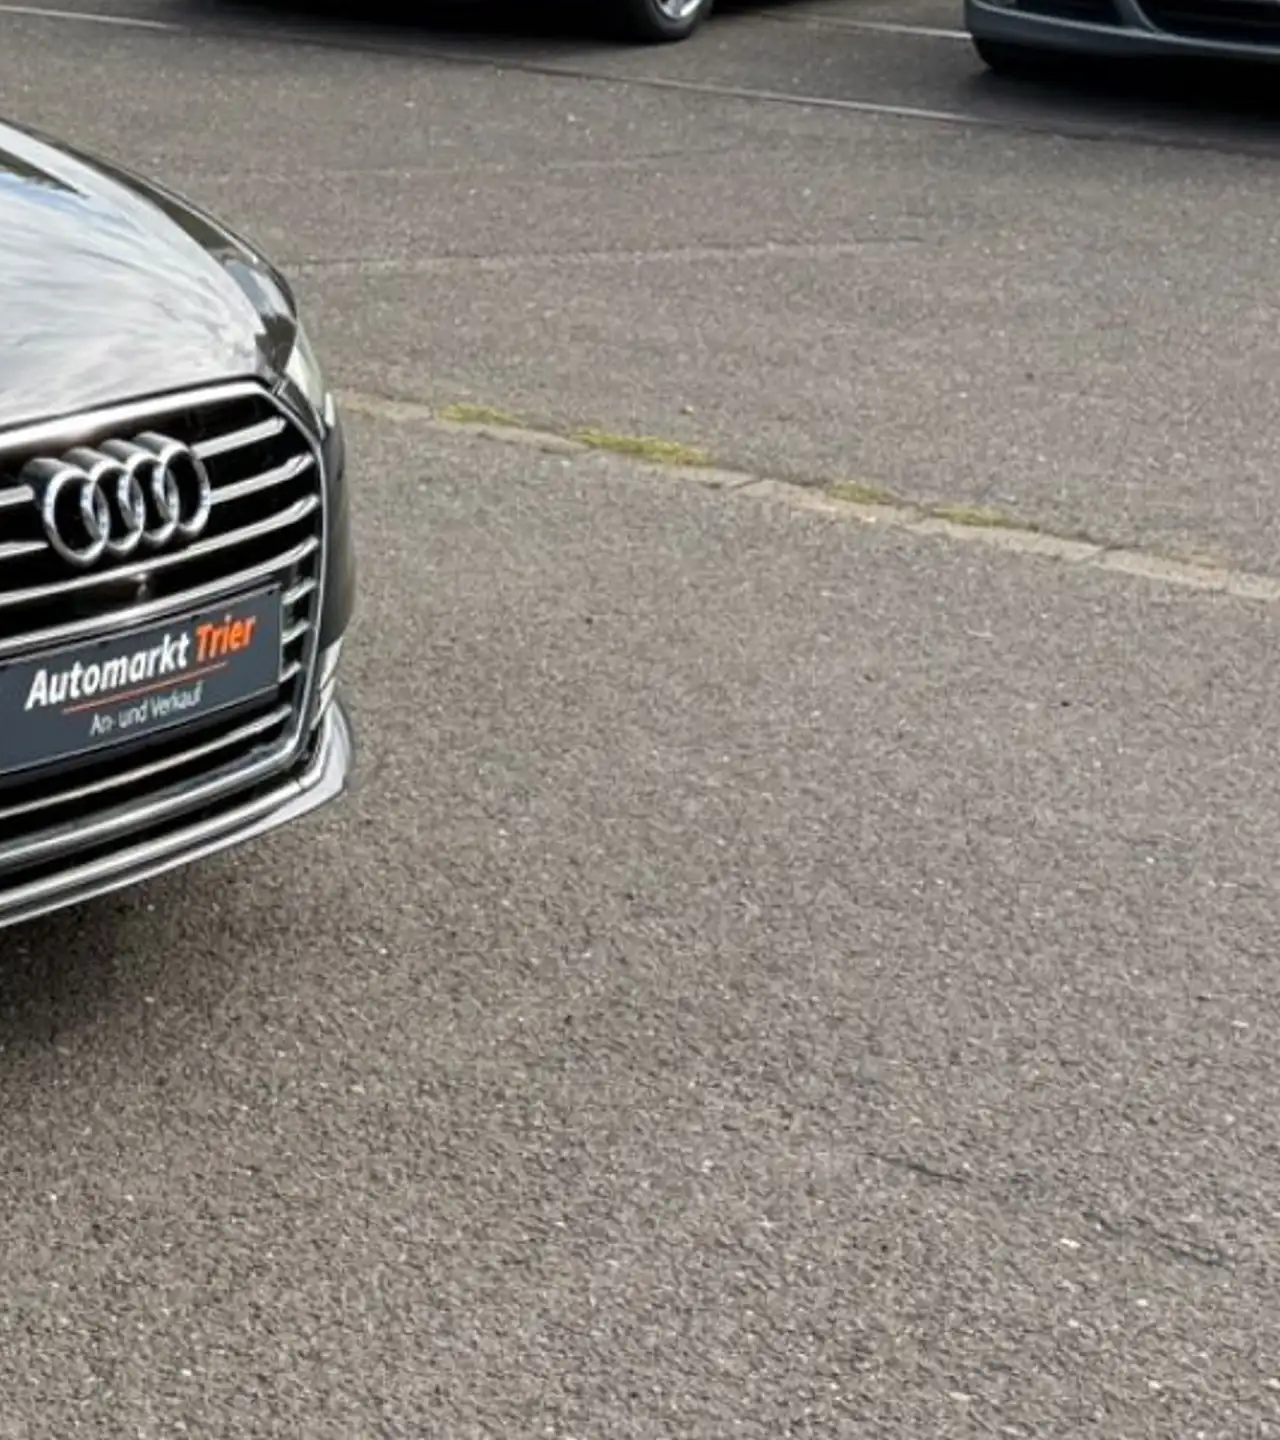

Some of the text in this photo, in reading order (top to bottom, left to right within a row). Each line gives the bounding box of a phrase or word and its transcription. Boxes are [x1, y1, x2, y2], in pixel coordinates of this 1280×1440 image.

[24, 614, 256, 710] Automarkt Trier
[118, 697, 149, 729] und
[151, 679, 204, 720] Verkauf
